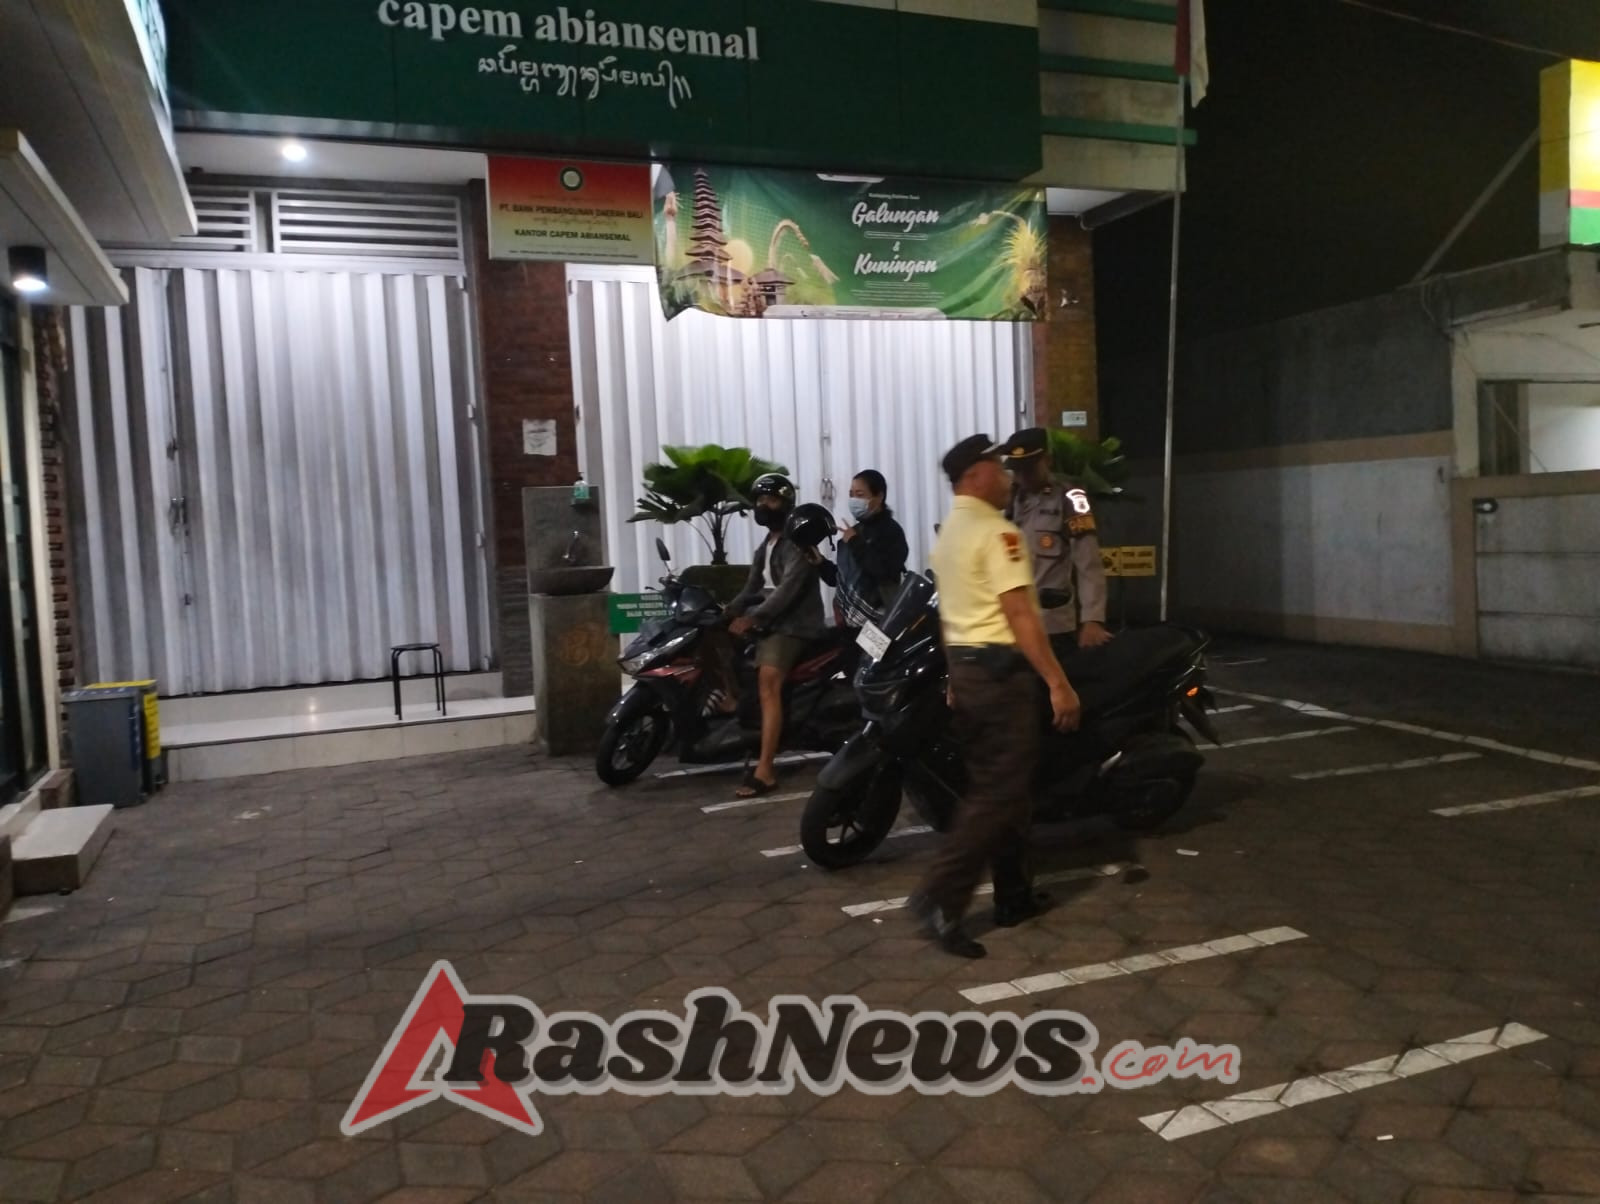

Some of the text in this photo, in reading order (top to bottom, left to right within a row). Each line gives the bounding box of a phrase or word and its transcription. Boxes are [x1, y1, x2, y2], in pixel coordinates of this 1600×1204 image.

[378, 0, 760, 61] capem abiansemal
[851, 201, 940, 233] Galungan
[514, 229, 632, 242] KANTOR CAPEM ABIANSEMAL
[853, 252, 938, 282] Kuningan
